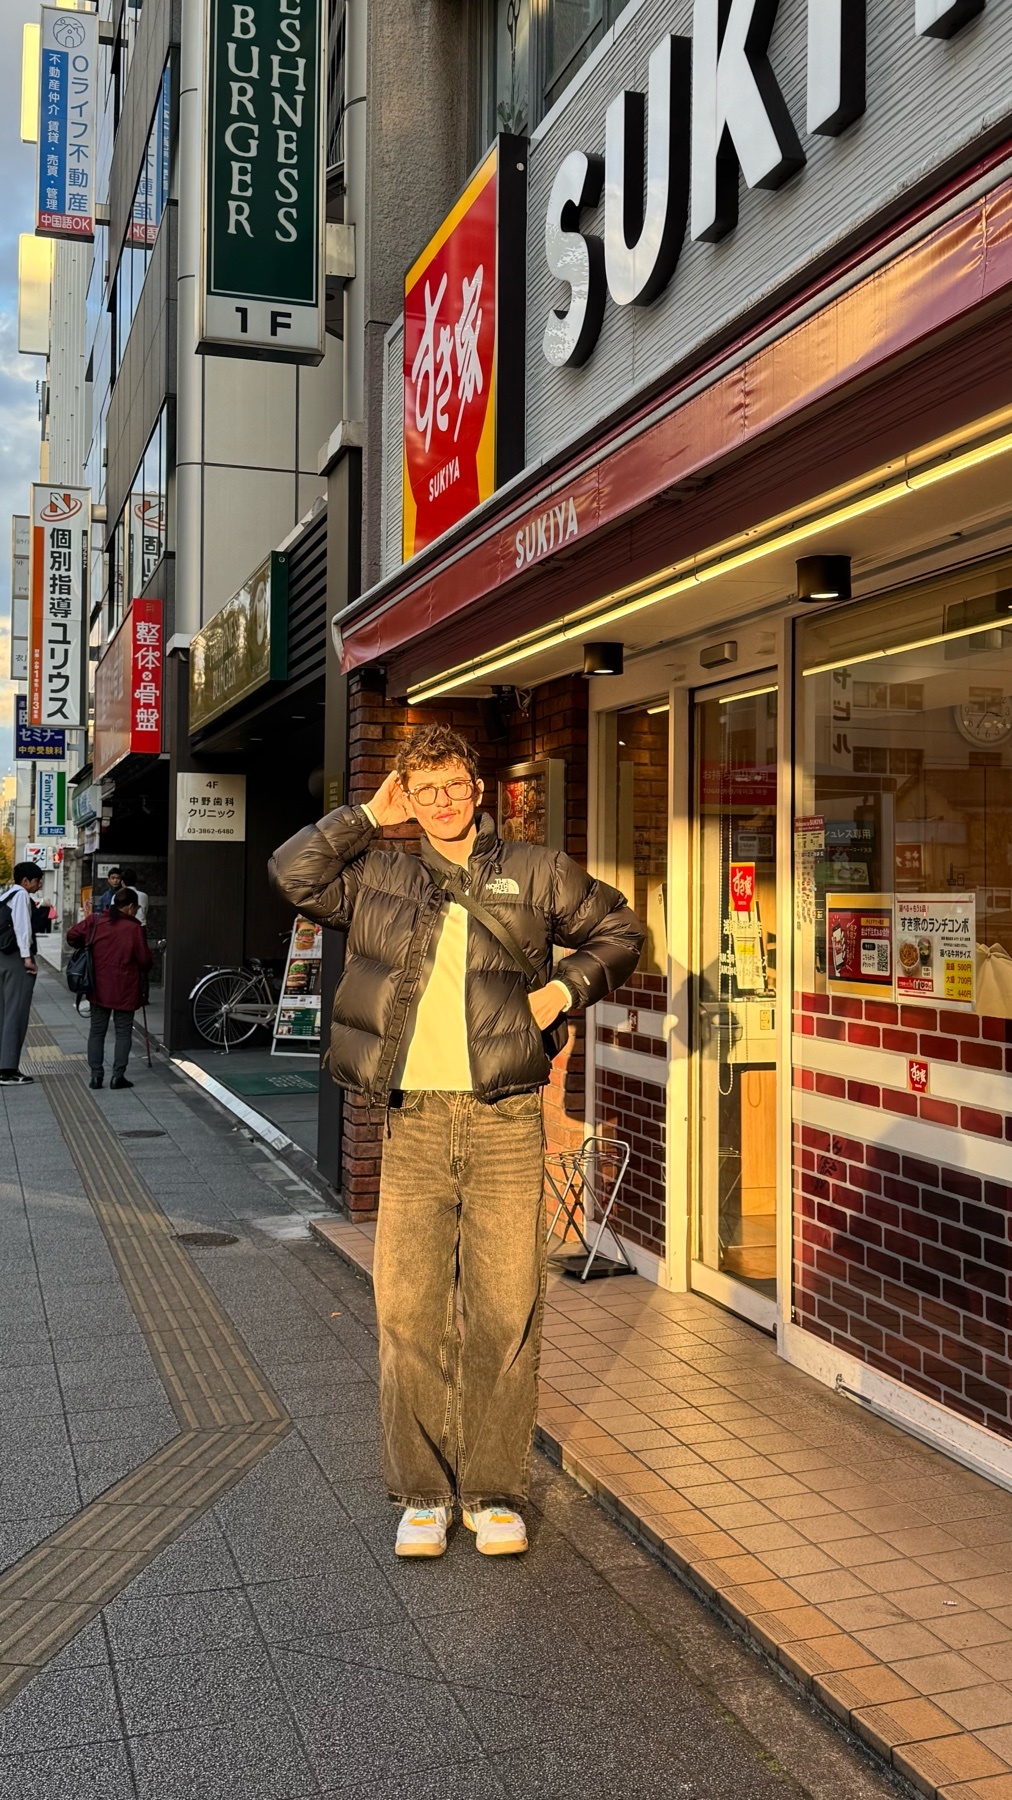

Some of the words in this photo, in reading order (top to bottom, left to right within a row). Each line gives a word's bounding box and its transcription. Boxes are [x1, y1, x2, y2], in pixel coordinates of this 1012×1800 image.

[48, 53, 61, 116] 不動産仲介
[224, 4, 260, 238] BURGER
[543, 0, 965, 369] SUK
[40, 213, 91, 231] 中国語OK
[428, 456, 461, 502] SUKIYA
[515, 497, 578, 569] SUKIYA
[47, 527, 72, 720] 個別指導ユリウス
[18, 729, 63, 742] セミナー
[18, 746, 62, 756] 中学受験科
[205, 780, 219, 789] 4F
[43, 773, 54, 825] FamilyMart
[189, 796, 235, 806] 中野歯科
[187, 808, 235, 819] クリニック
[187, 827, 235, 835] 03-3862-6480
[900, 917, 970, 934] すき家のランチコンボ
[957, 963, 972, 972] 500円
[957, 976, 972, 985] 700円
